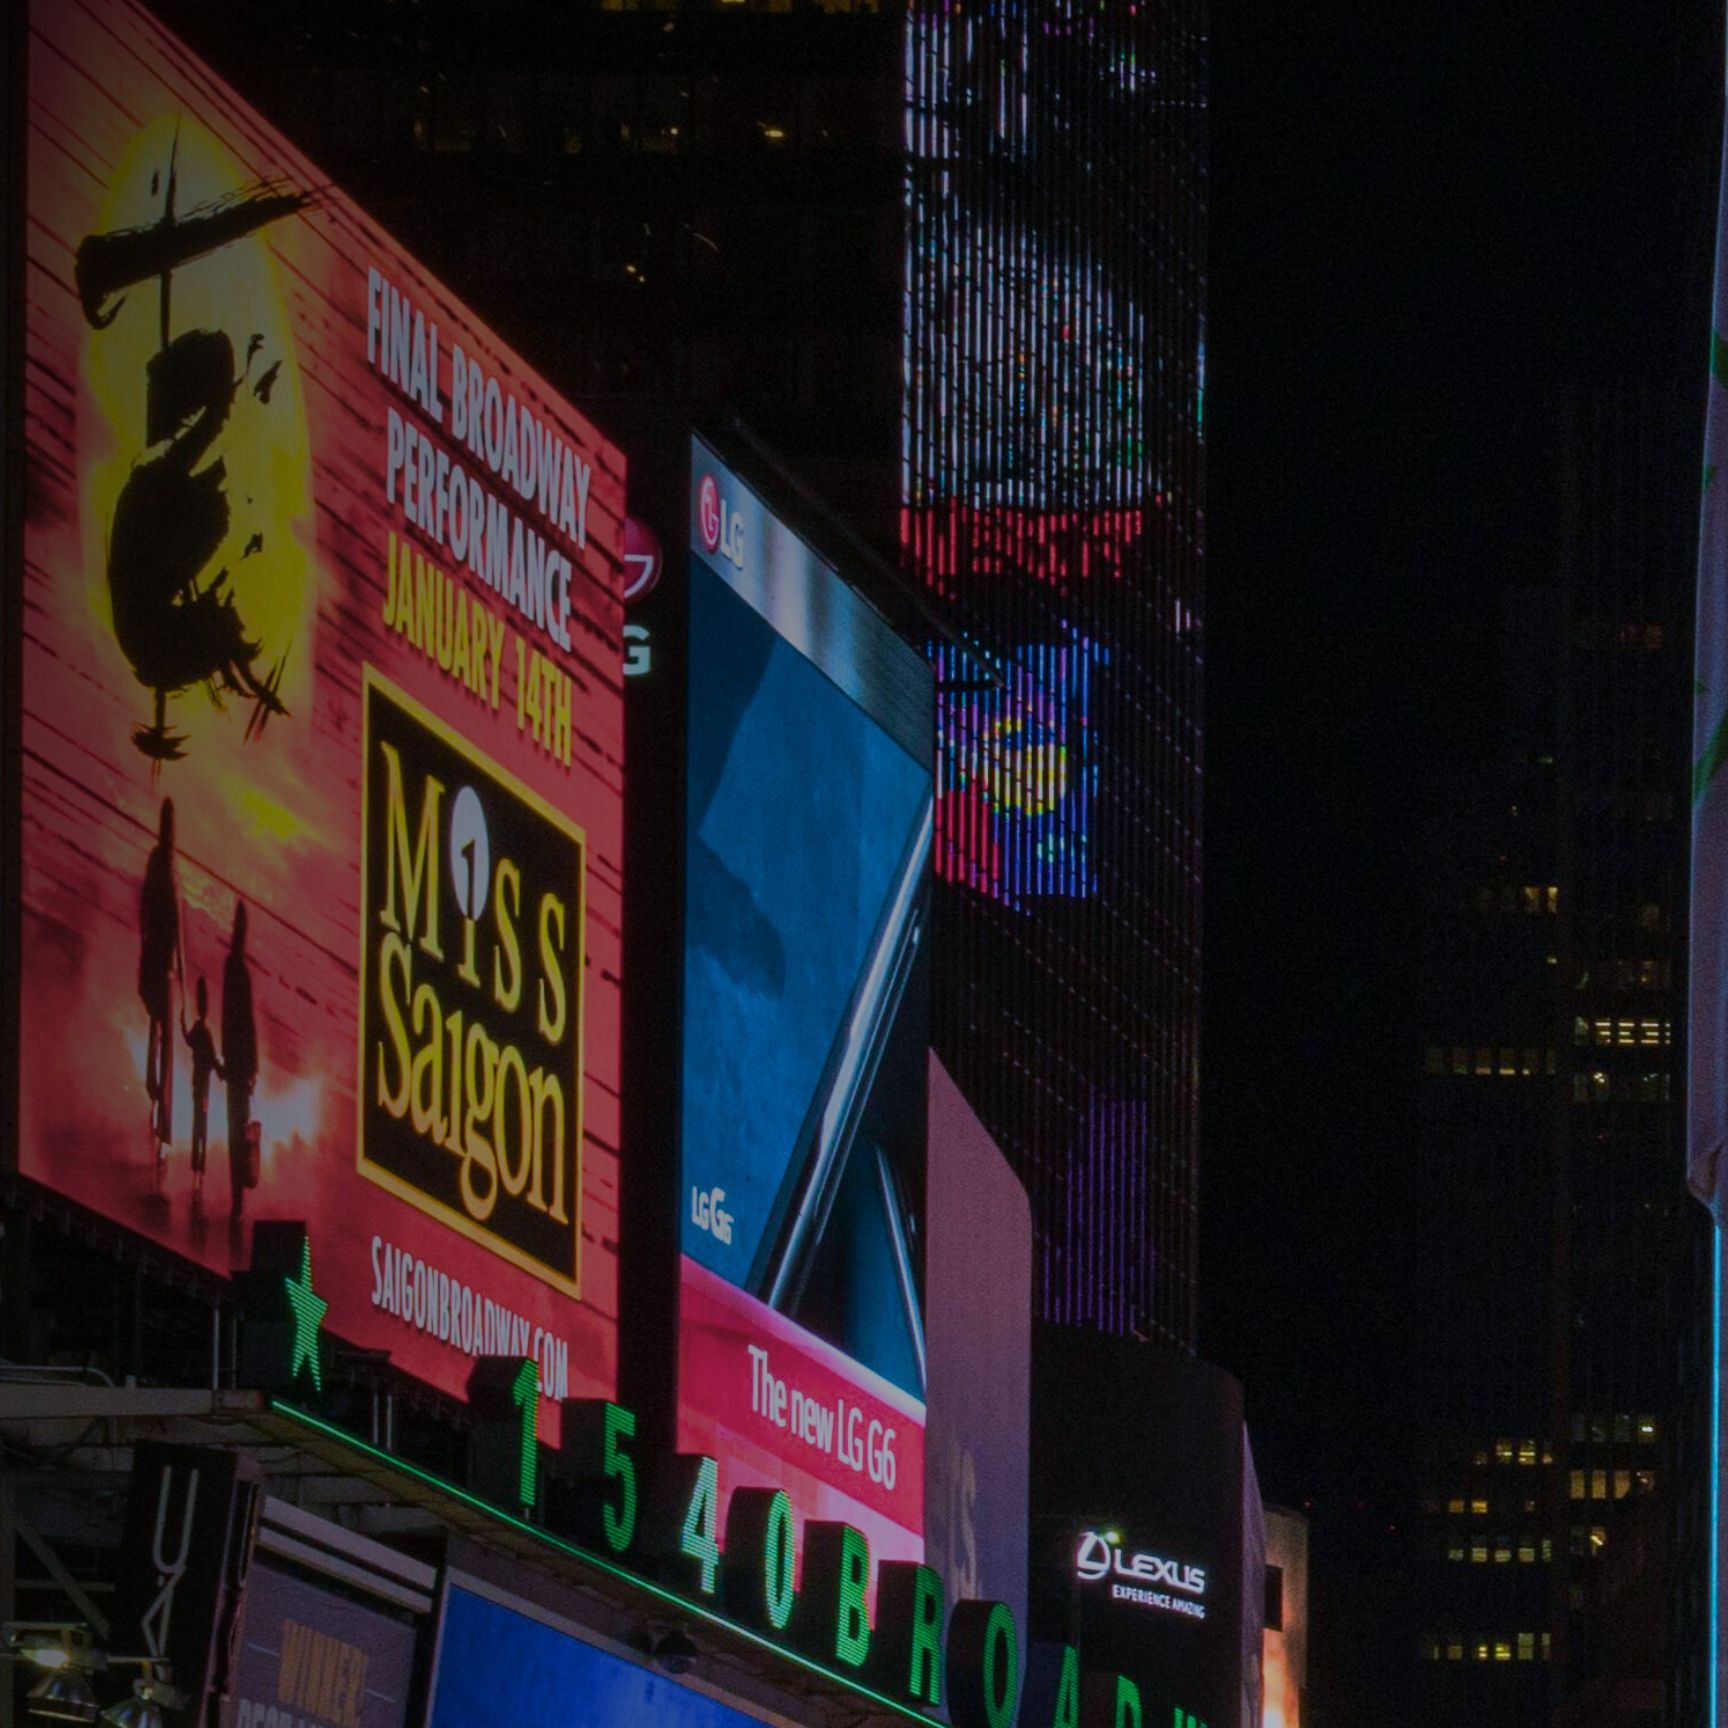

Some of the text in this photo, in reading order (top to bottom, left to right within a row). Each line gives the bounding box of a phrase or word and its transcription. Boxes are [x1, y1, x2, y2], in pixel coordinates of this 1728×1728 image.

[366, 264, 591, 554] FINAL BROADWAY
[386, 405, 573, 654] PERFORMANCE
[719, 496, 746, 571] LG
[381, 547, 573, 769] JANUARY 14TH
[378, 933, 570, 1226] Saigon
[513, 1355, 795, 1632] 1540
[748, 1343, 897, 1492] The new LG G6
[1113, 1552, 1206, 1595] LEXUS
